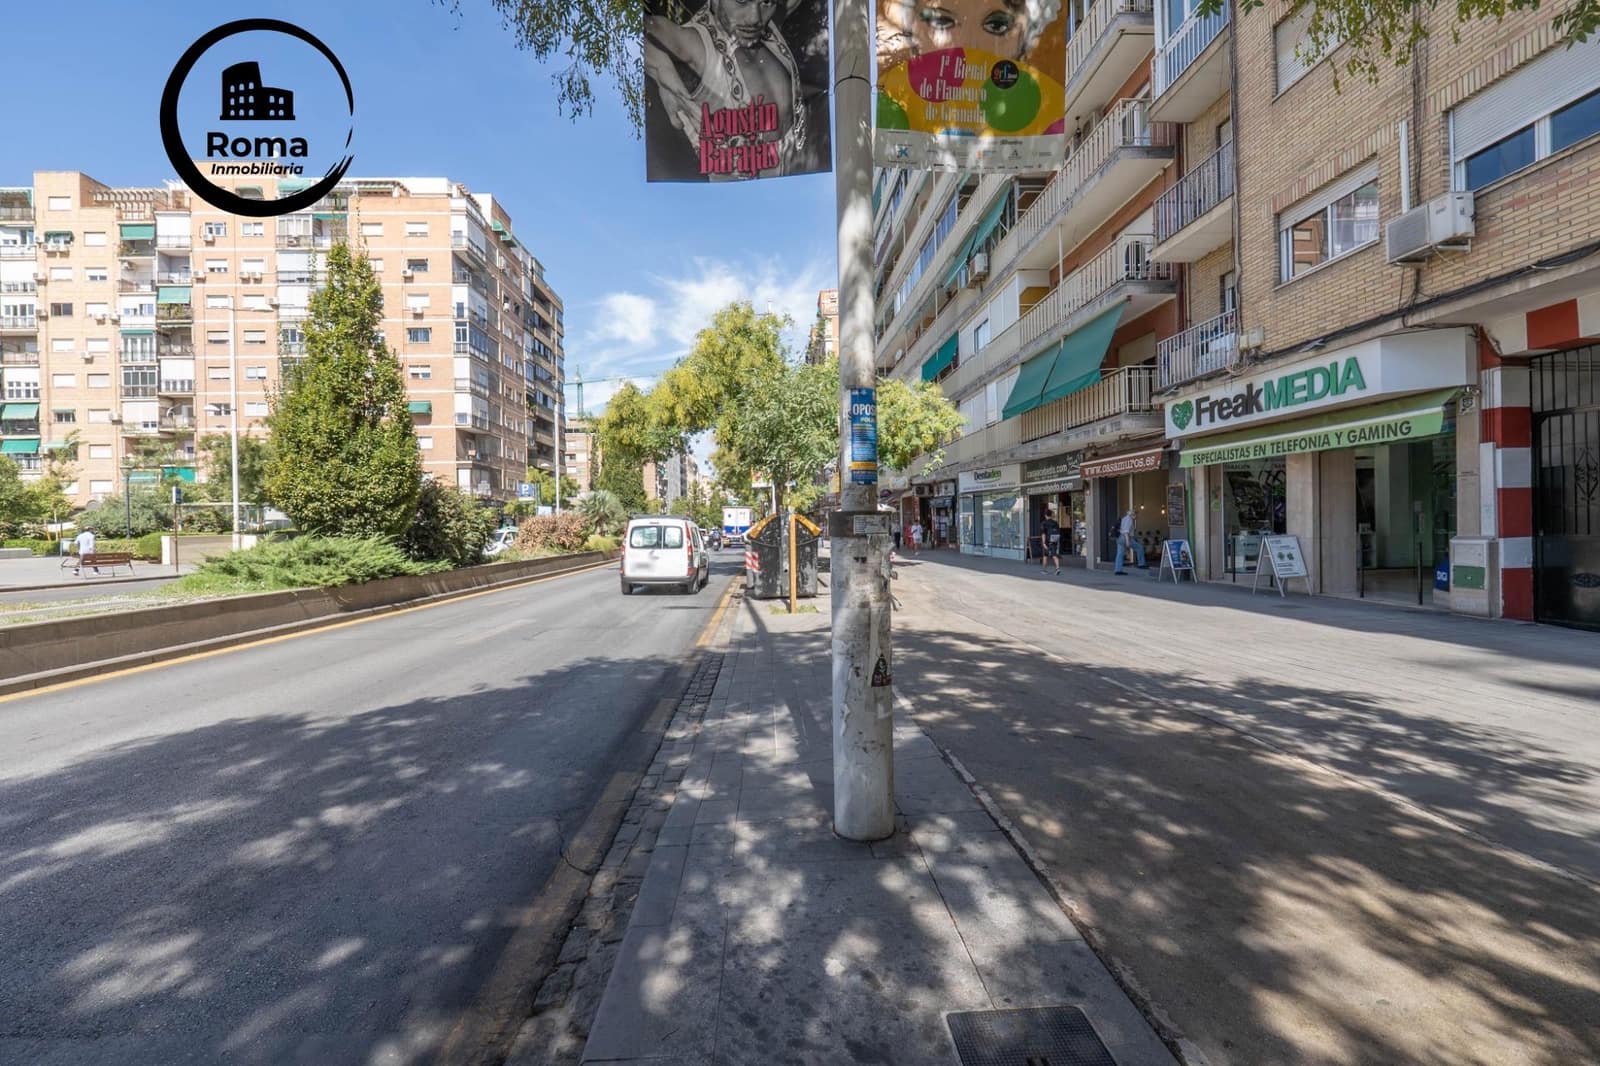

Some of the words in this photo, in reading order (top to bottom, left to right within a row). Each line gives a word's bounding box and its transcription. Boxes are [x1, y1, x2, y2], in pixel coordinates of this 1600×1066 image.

[954, 56, 987, 81] Bienal
[920, 78, 933, 98] de
[702, 95, 779, 144] Agustín
[699, 139, 781, 178] Barajas
[1192, 445, 1250, 465] ESPECIALISTAS
[1253, 444, 1267, 457] EN
[1270, 435, 1331, 454] TELEFONIA
[1336, 431, 1343, 446] Y
[1347, 420, 1412, 444] GAMING
[521, 484, 529, 495] P
